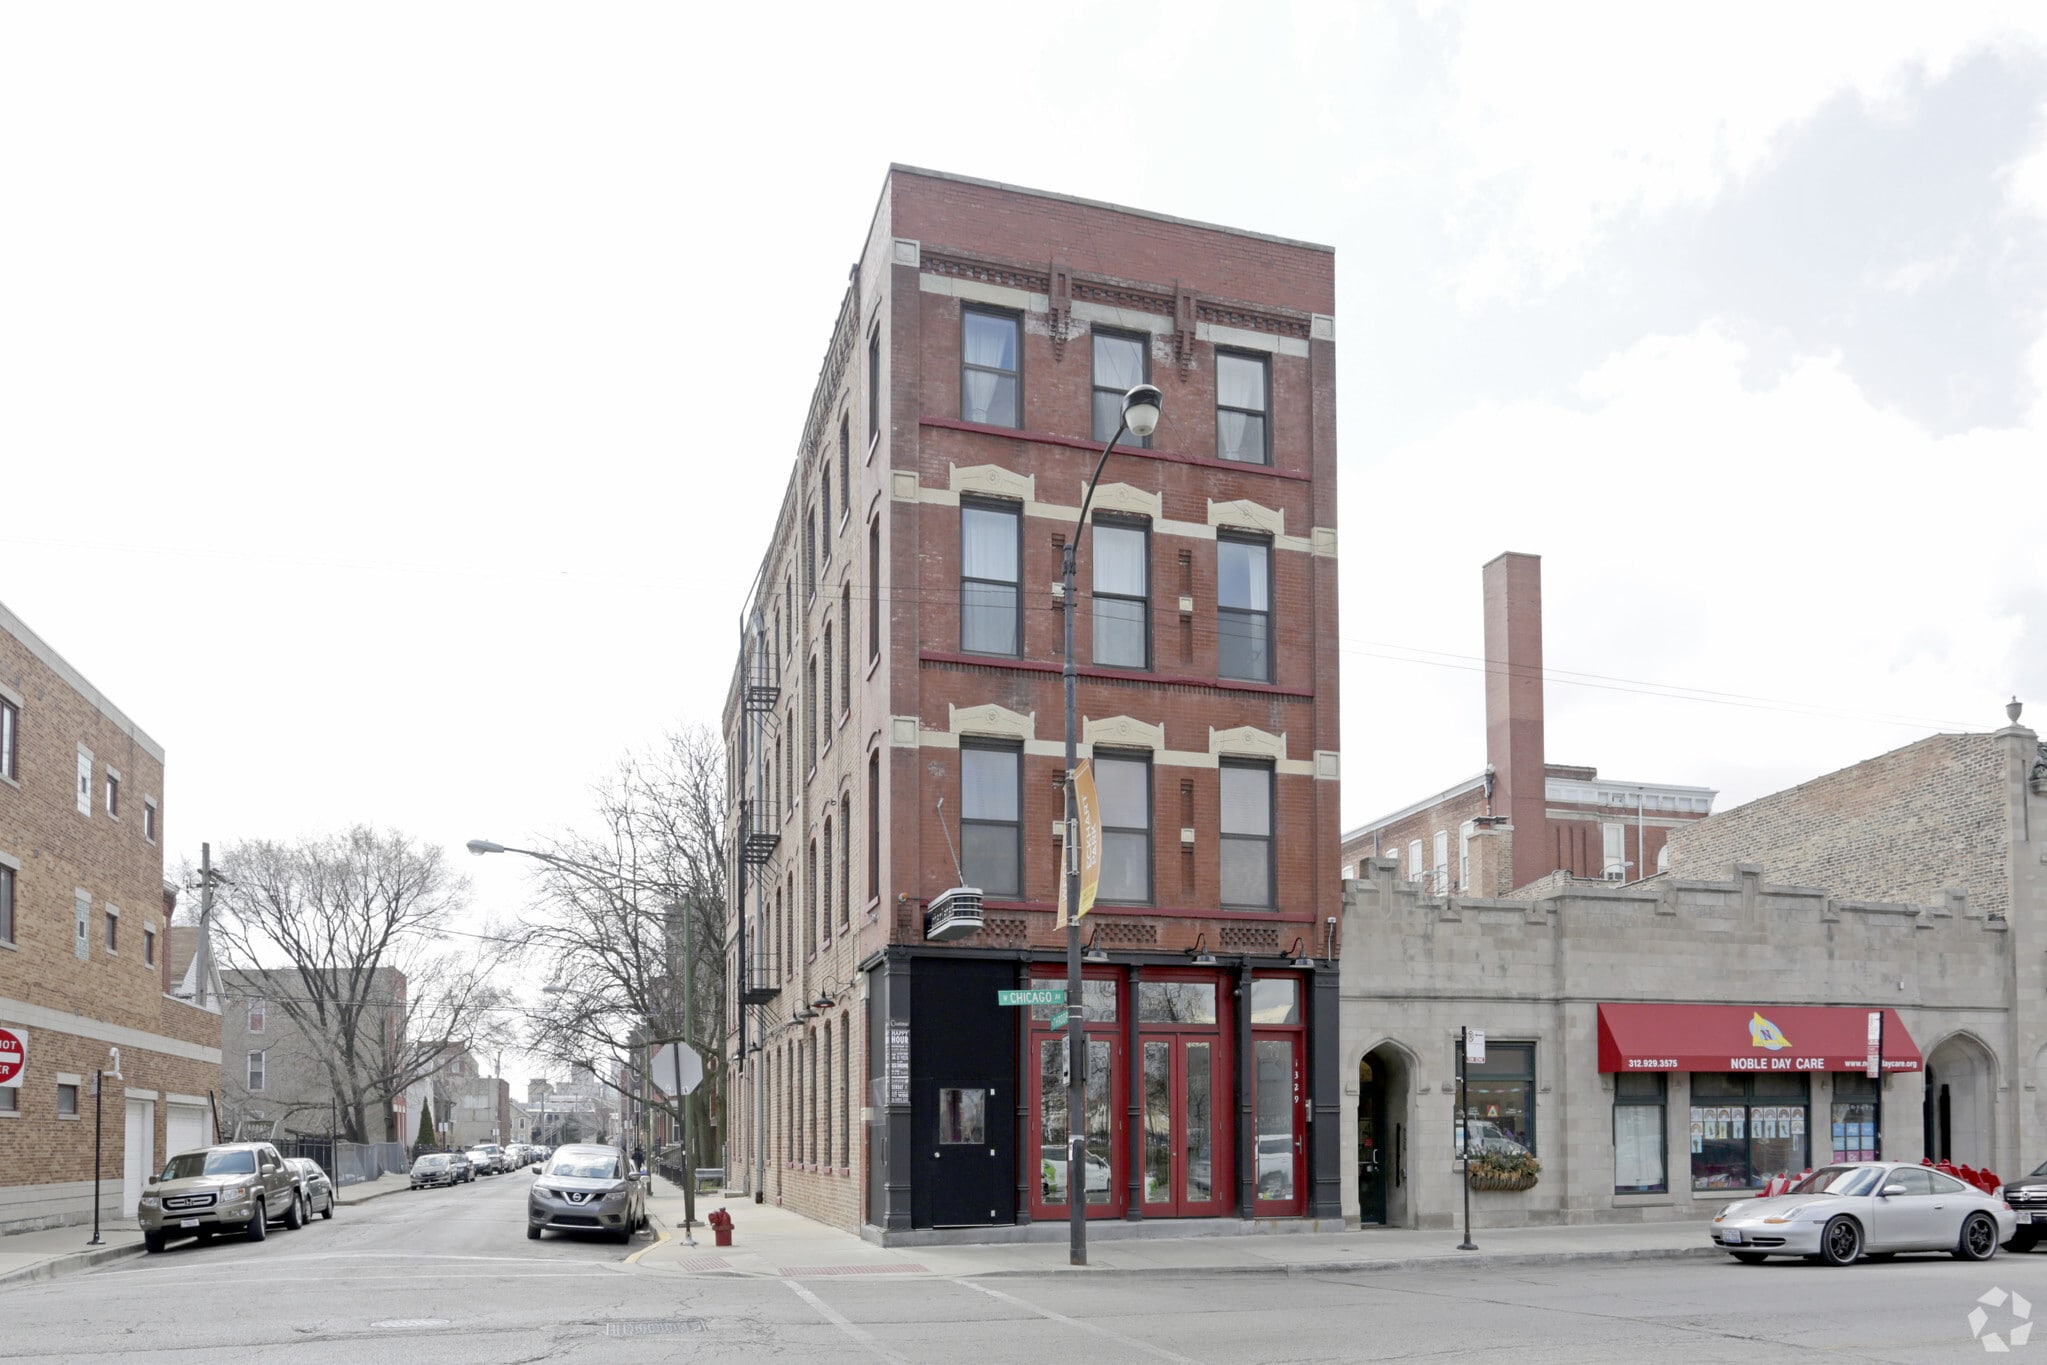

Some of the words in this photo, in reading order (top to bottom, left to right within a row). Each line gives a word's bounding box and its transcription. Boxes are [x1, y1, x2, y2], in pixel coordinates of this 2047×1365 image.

[1081, 796, 1092, 869] ECKHART
[1010, 991, 1052, 1003] CHICAGO
[0, 1040, 16, 1050] OT
[891, 1036, 909, 1044] HOUR
[1628, 1059, 1678, 1068] 312.929.3575
[1730, 1058, 1768, 1070] NOBLE
[1771, 1058, 1791, 1070] DAY
[1796, 1058, 1825, 1070] CARE
